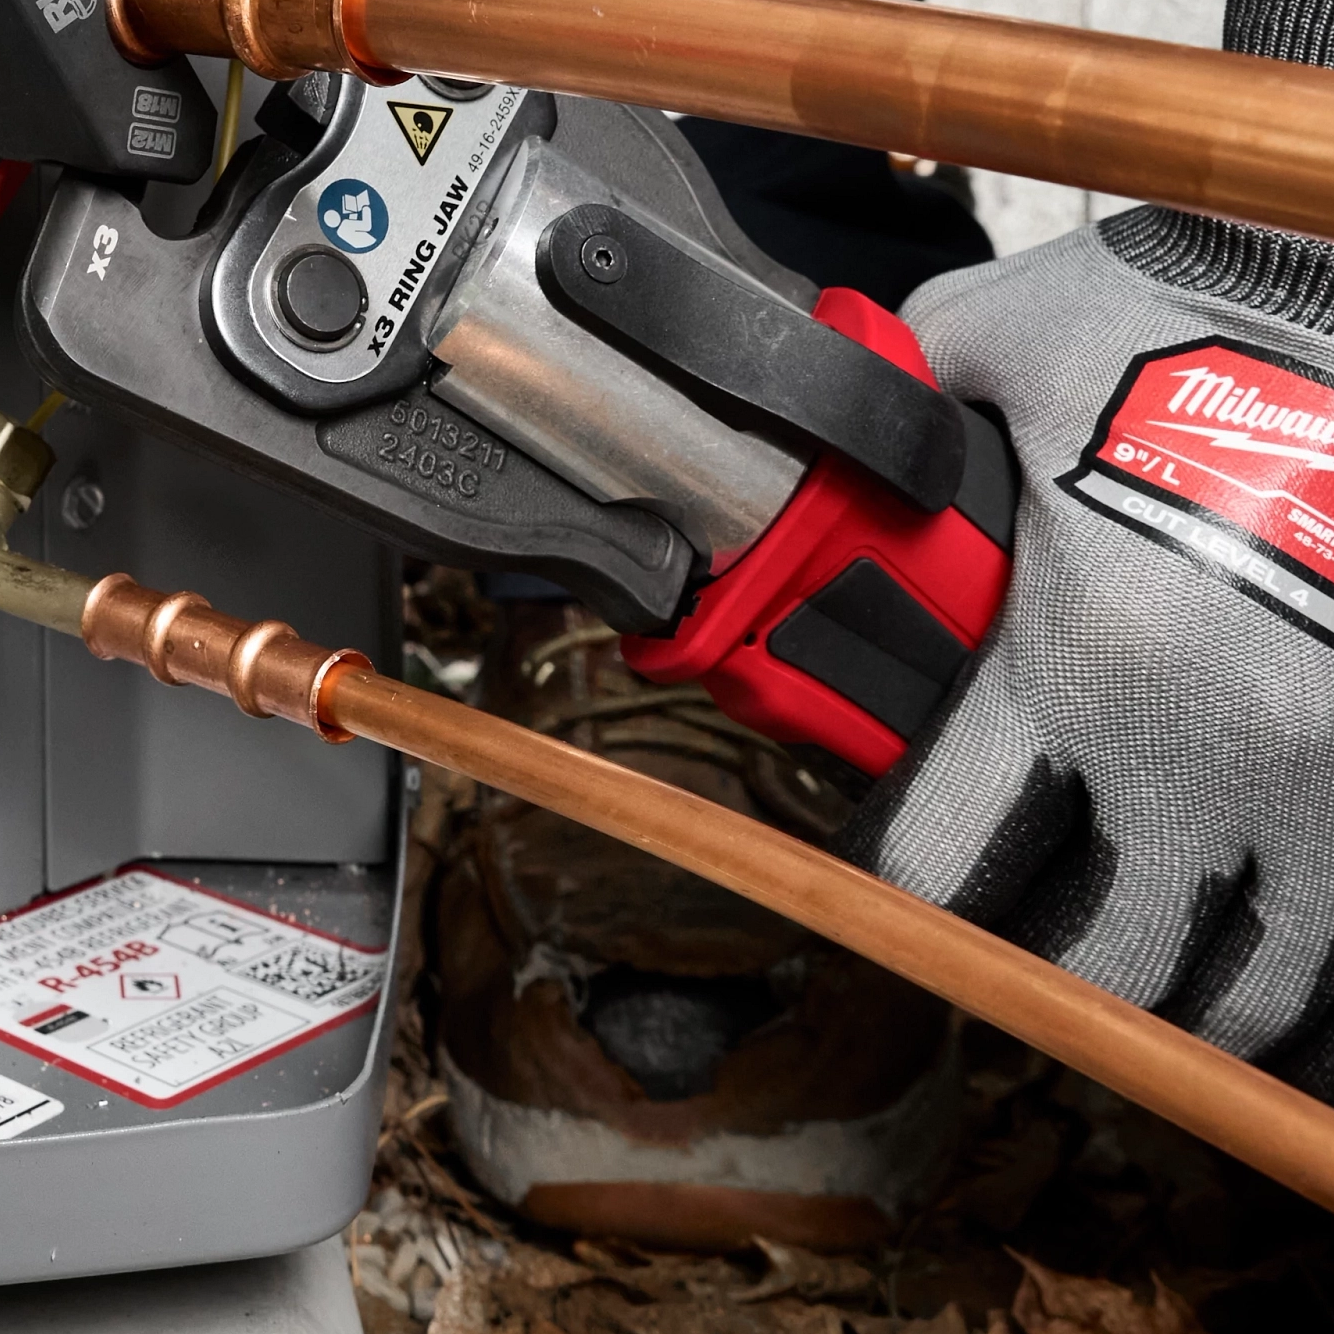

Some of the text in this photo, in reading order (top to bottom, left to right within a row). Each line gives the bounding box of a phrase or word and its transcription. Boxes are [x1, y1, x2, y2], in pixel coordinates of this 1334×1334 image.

[136, 93, 178, 117] M18
[131, 129, 173, 153] M12
[388, 239, 437, 312] RING
[433, 174, 470, 236] JAW
[468, 86, 523, 174] 49-16-2459X
[378, 433, 479, 497] 2403C
[390, 399, 507, 471] 6013211
[1122, 496, 1312, 608] CUT LEVEL 4
[37, 938, 163, 995] R-454B
